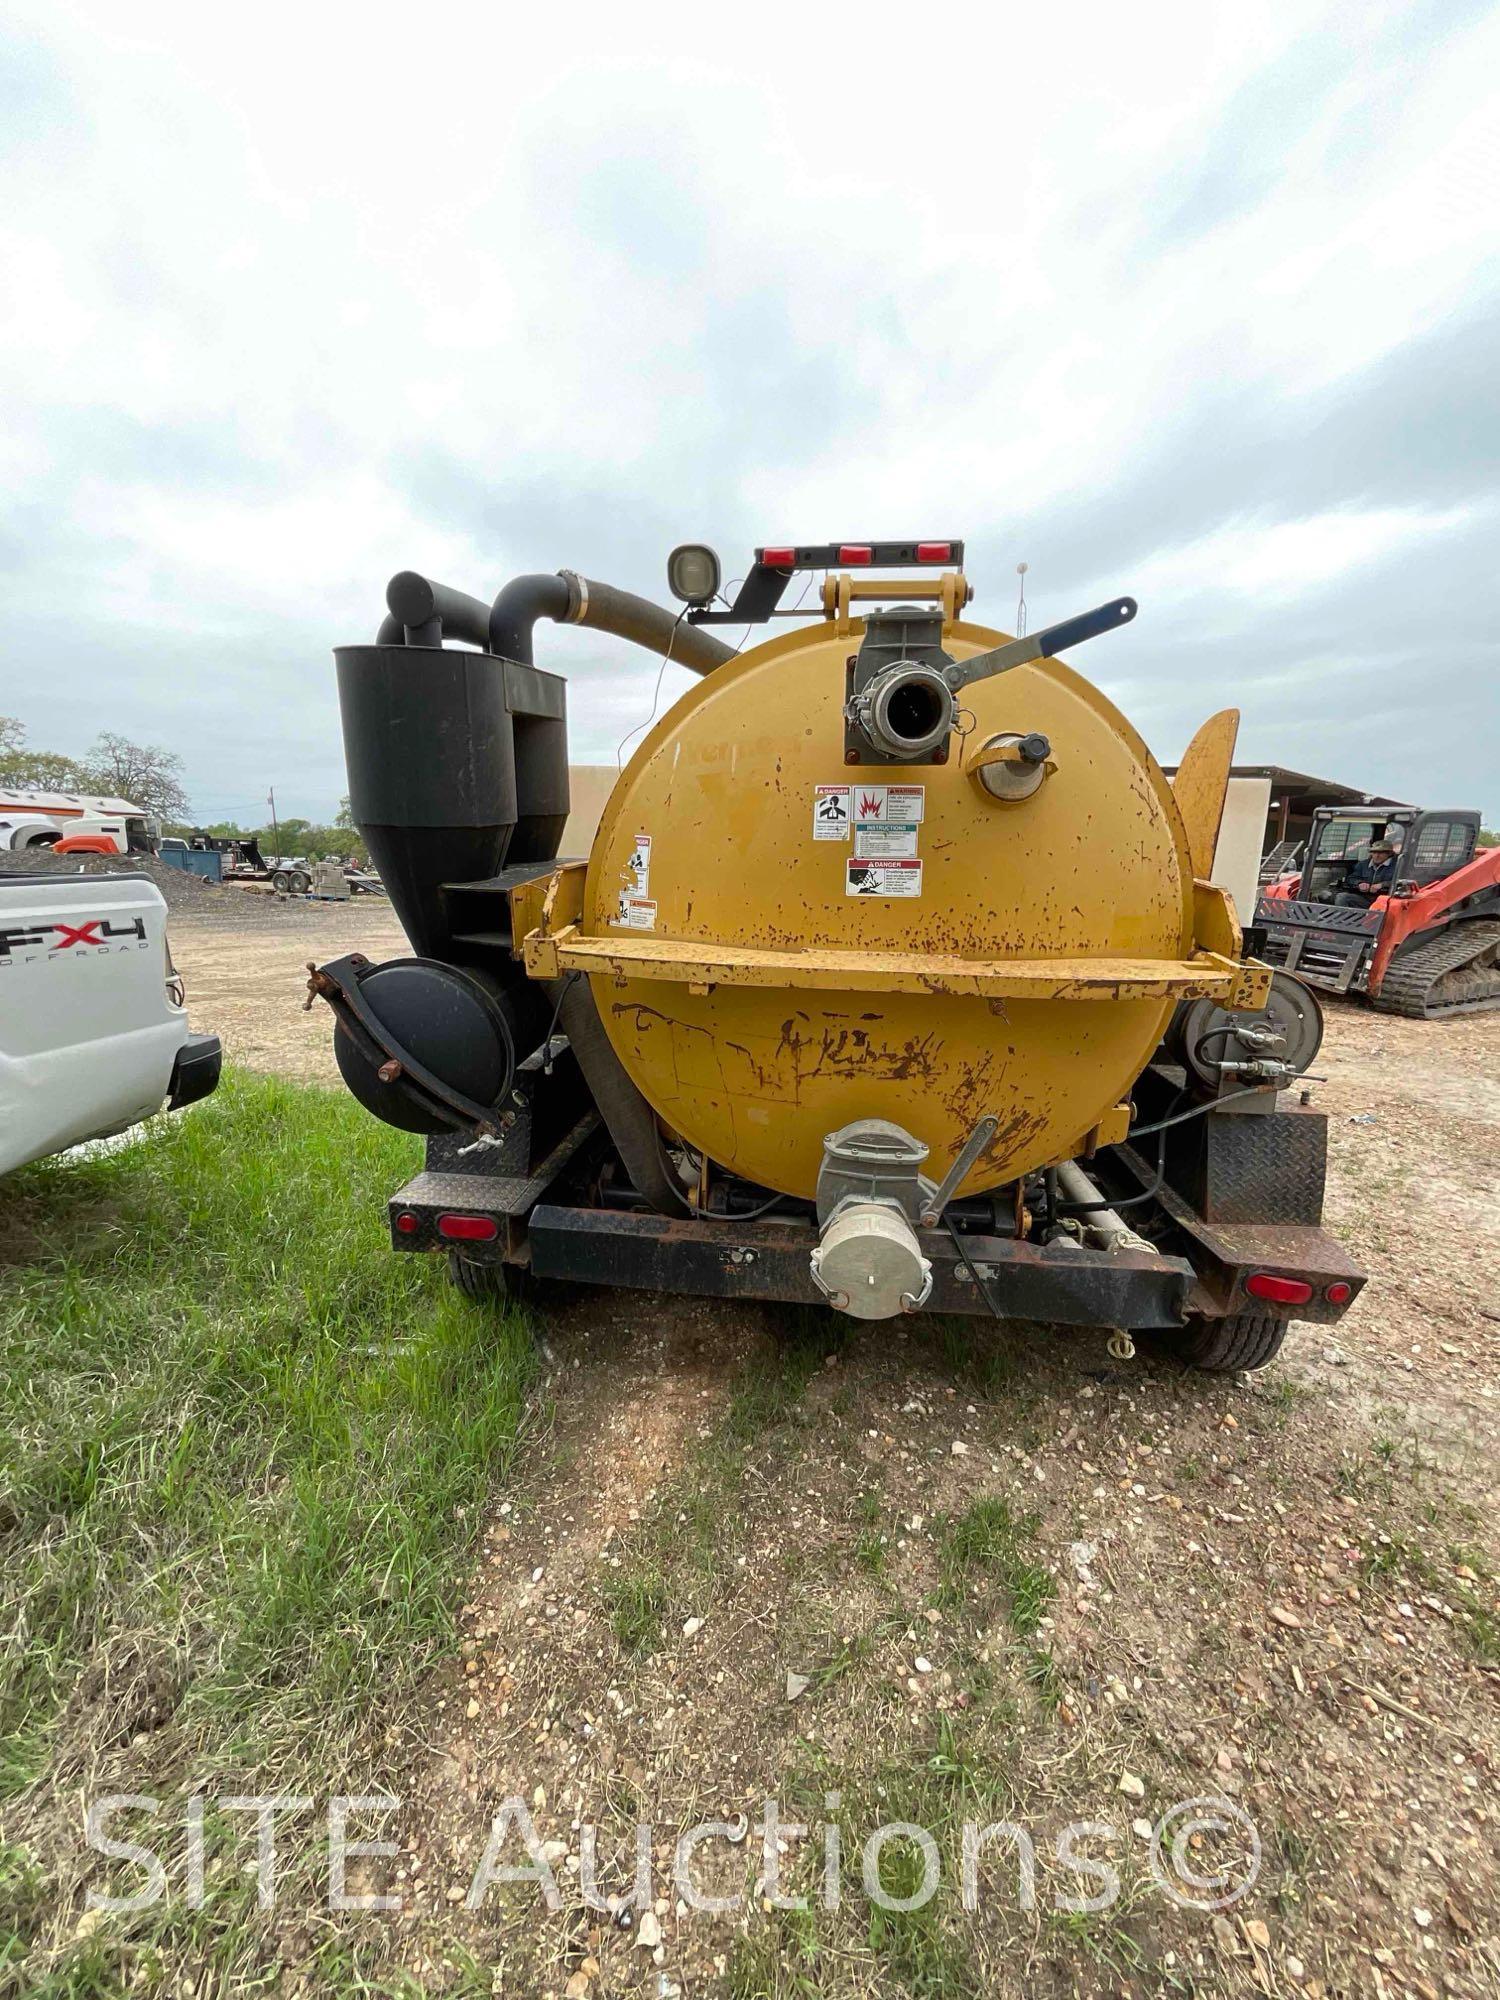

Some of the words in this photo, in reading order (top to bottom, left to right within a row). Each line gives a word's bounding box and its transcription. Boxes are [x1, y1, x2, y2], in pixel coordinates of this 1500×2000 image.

[0, 916, 147, 955] FX4
[0, 953, 59, 966] OFF
[76, 942, 149, 957] ROAD
